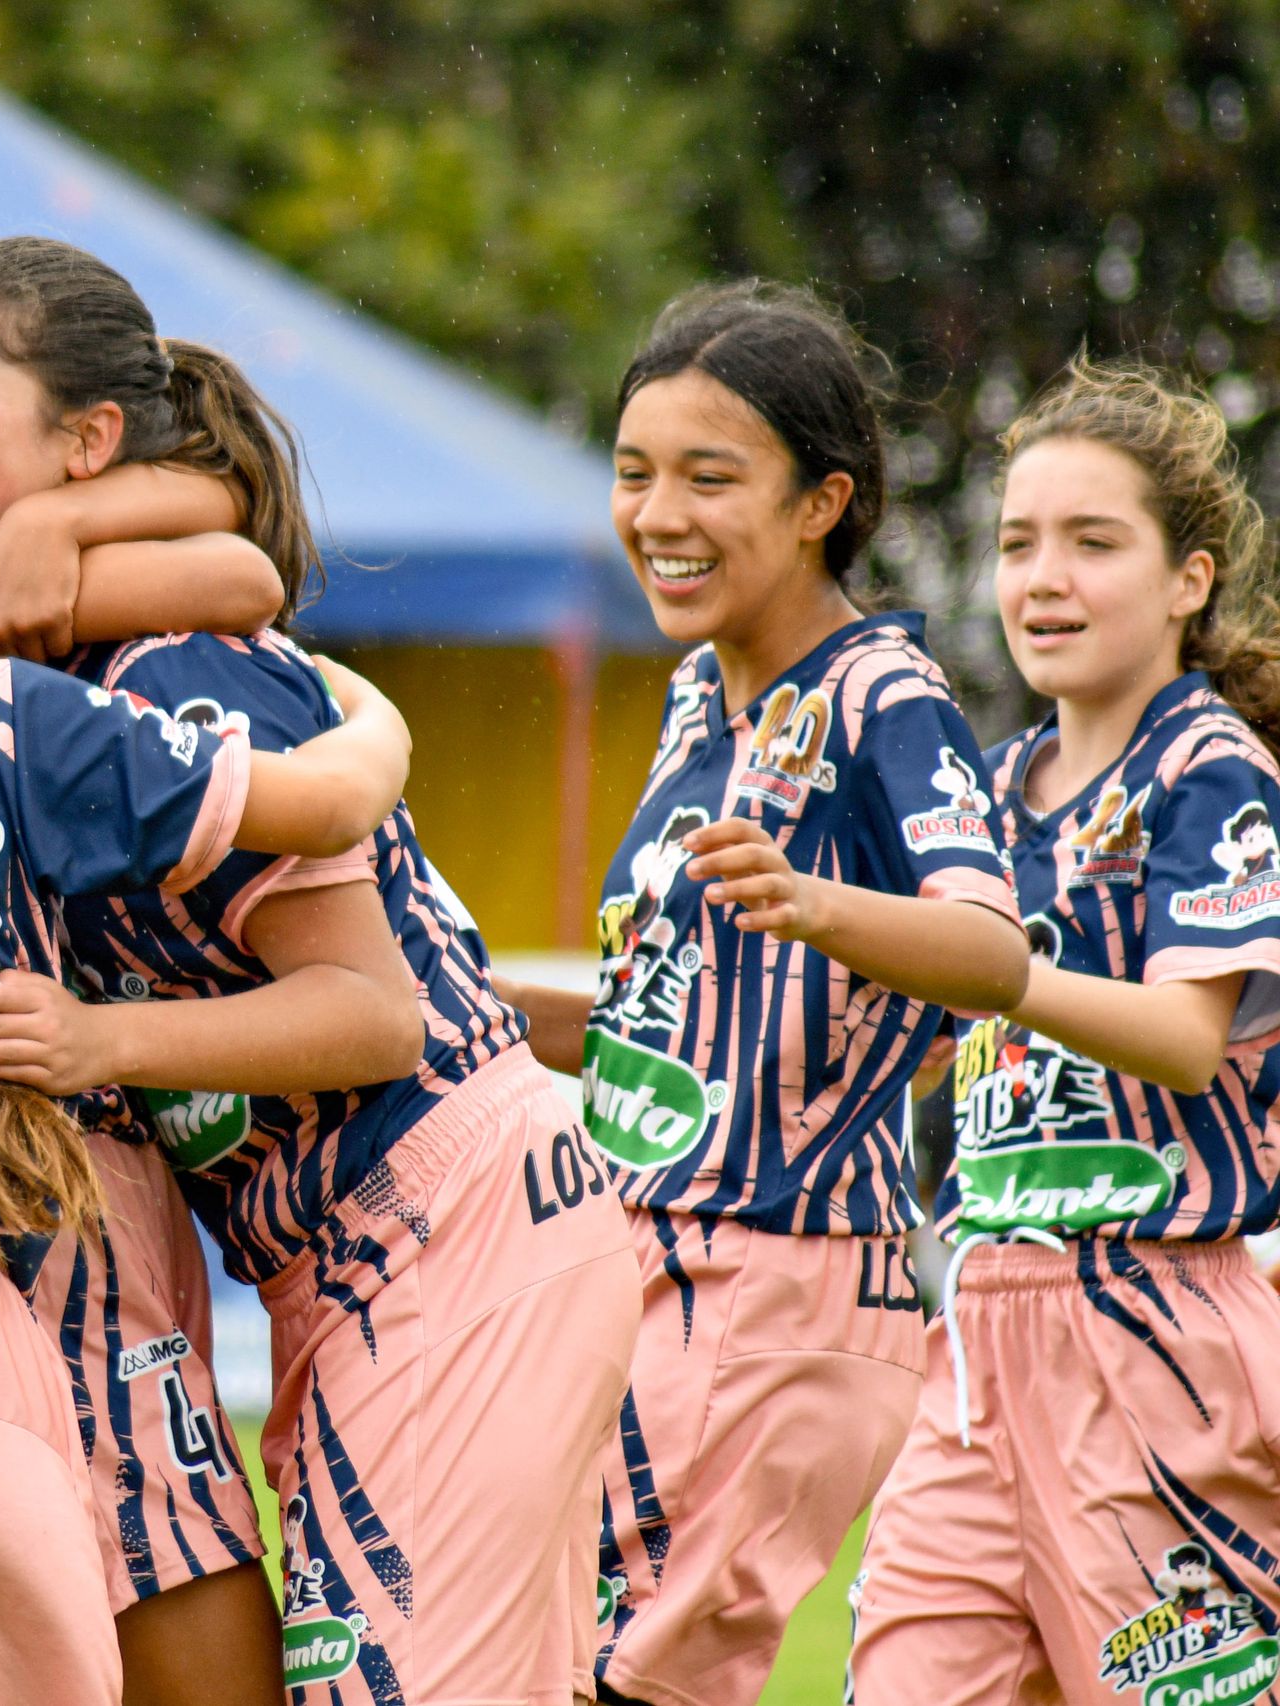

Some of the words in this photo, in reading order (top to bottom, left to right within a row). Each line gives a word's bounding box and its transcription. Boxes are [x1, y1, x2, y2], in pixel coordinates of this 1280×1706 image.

[908, 818, 958, 844] LOS
[1177, 895, 1225, 917] LOS
[524, 1123, 605, 1226] LOS
[149, 1336, 188, 1364] JMG
[162, 1373, 230, 1480] 4
[1110, 1601, 1182, 1665] BABY
